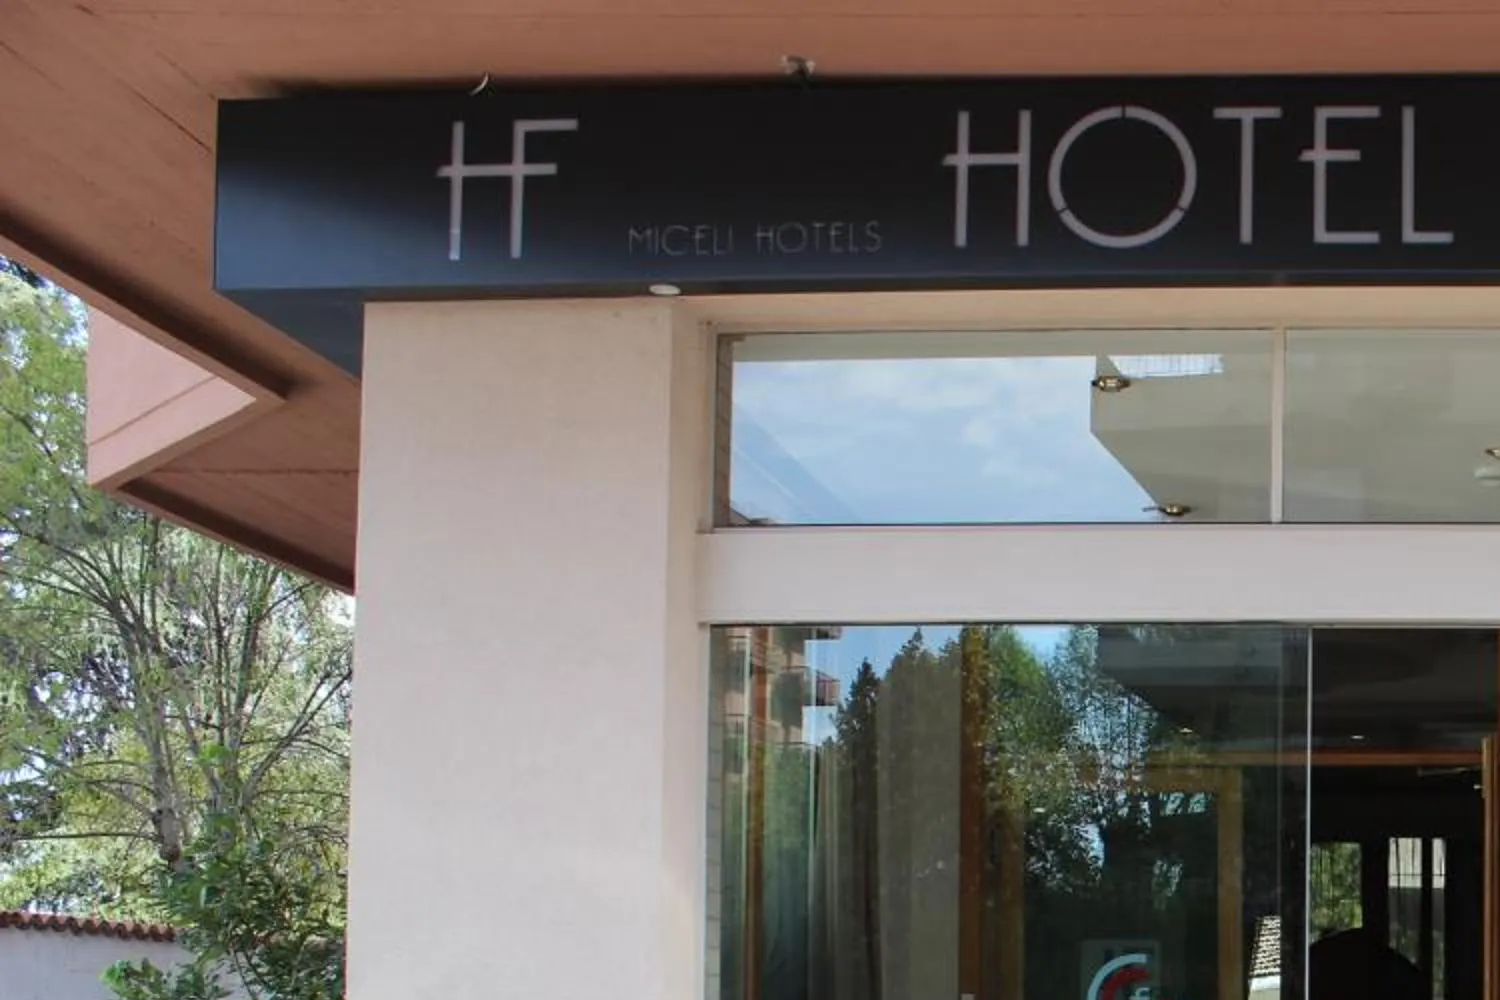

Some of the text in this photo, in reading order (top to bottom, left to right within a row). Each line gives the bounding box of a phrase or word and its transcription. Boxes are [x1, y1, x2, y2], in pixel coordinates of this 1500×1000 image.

[437, 116, 578, 261] HF
[627, 219, 884, 257] MICELI HOTELS
[942, 104, 1455, 248] HOTEL
